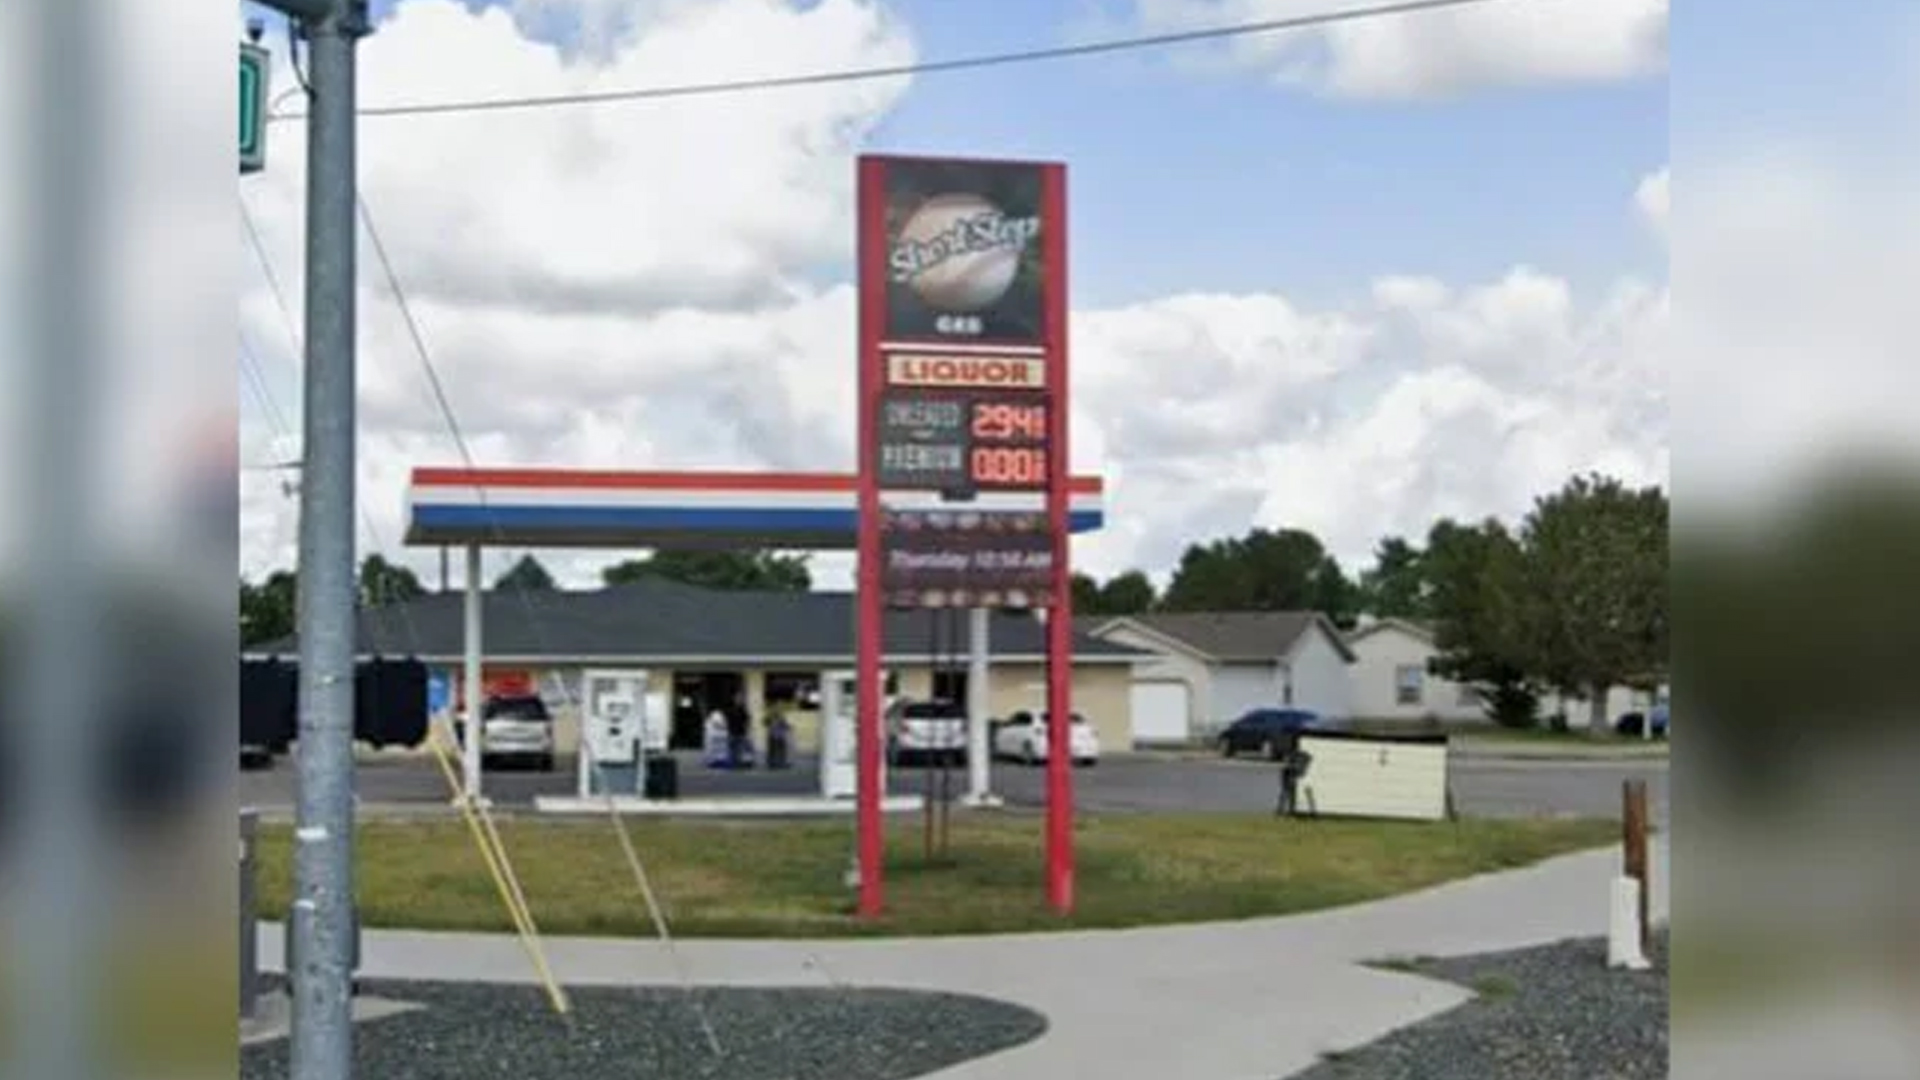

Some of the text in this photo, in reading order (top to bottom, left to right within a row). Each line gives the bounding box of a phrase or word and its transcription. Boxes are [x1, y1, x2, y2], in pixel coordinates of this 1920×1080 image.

[902, 360, 1029, 383] LIQUOR
[882, 443, 962, 470] PREMIUM
[889, 550, 969, 572] Thursday
